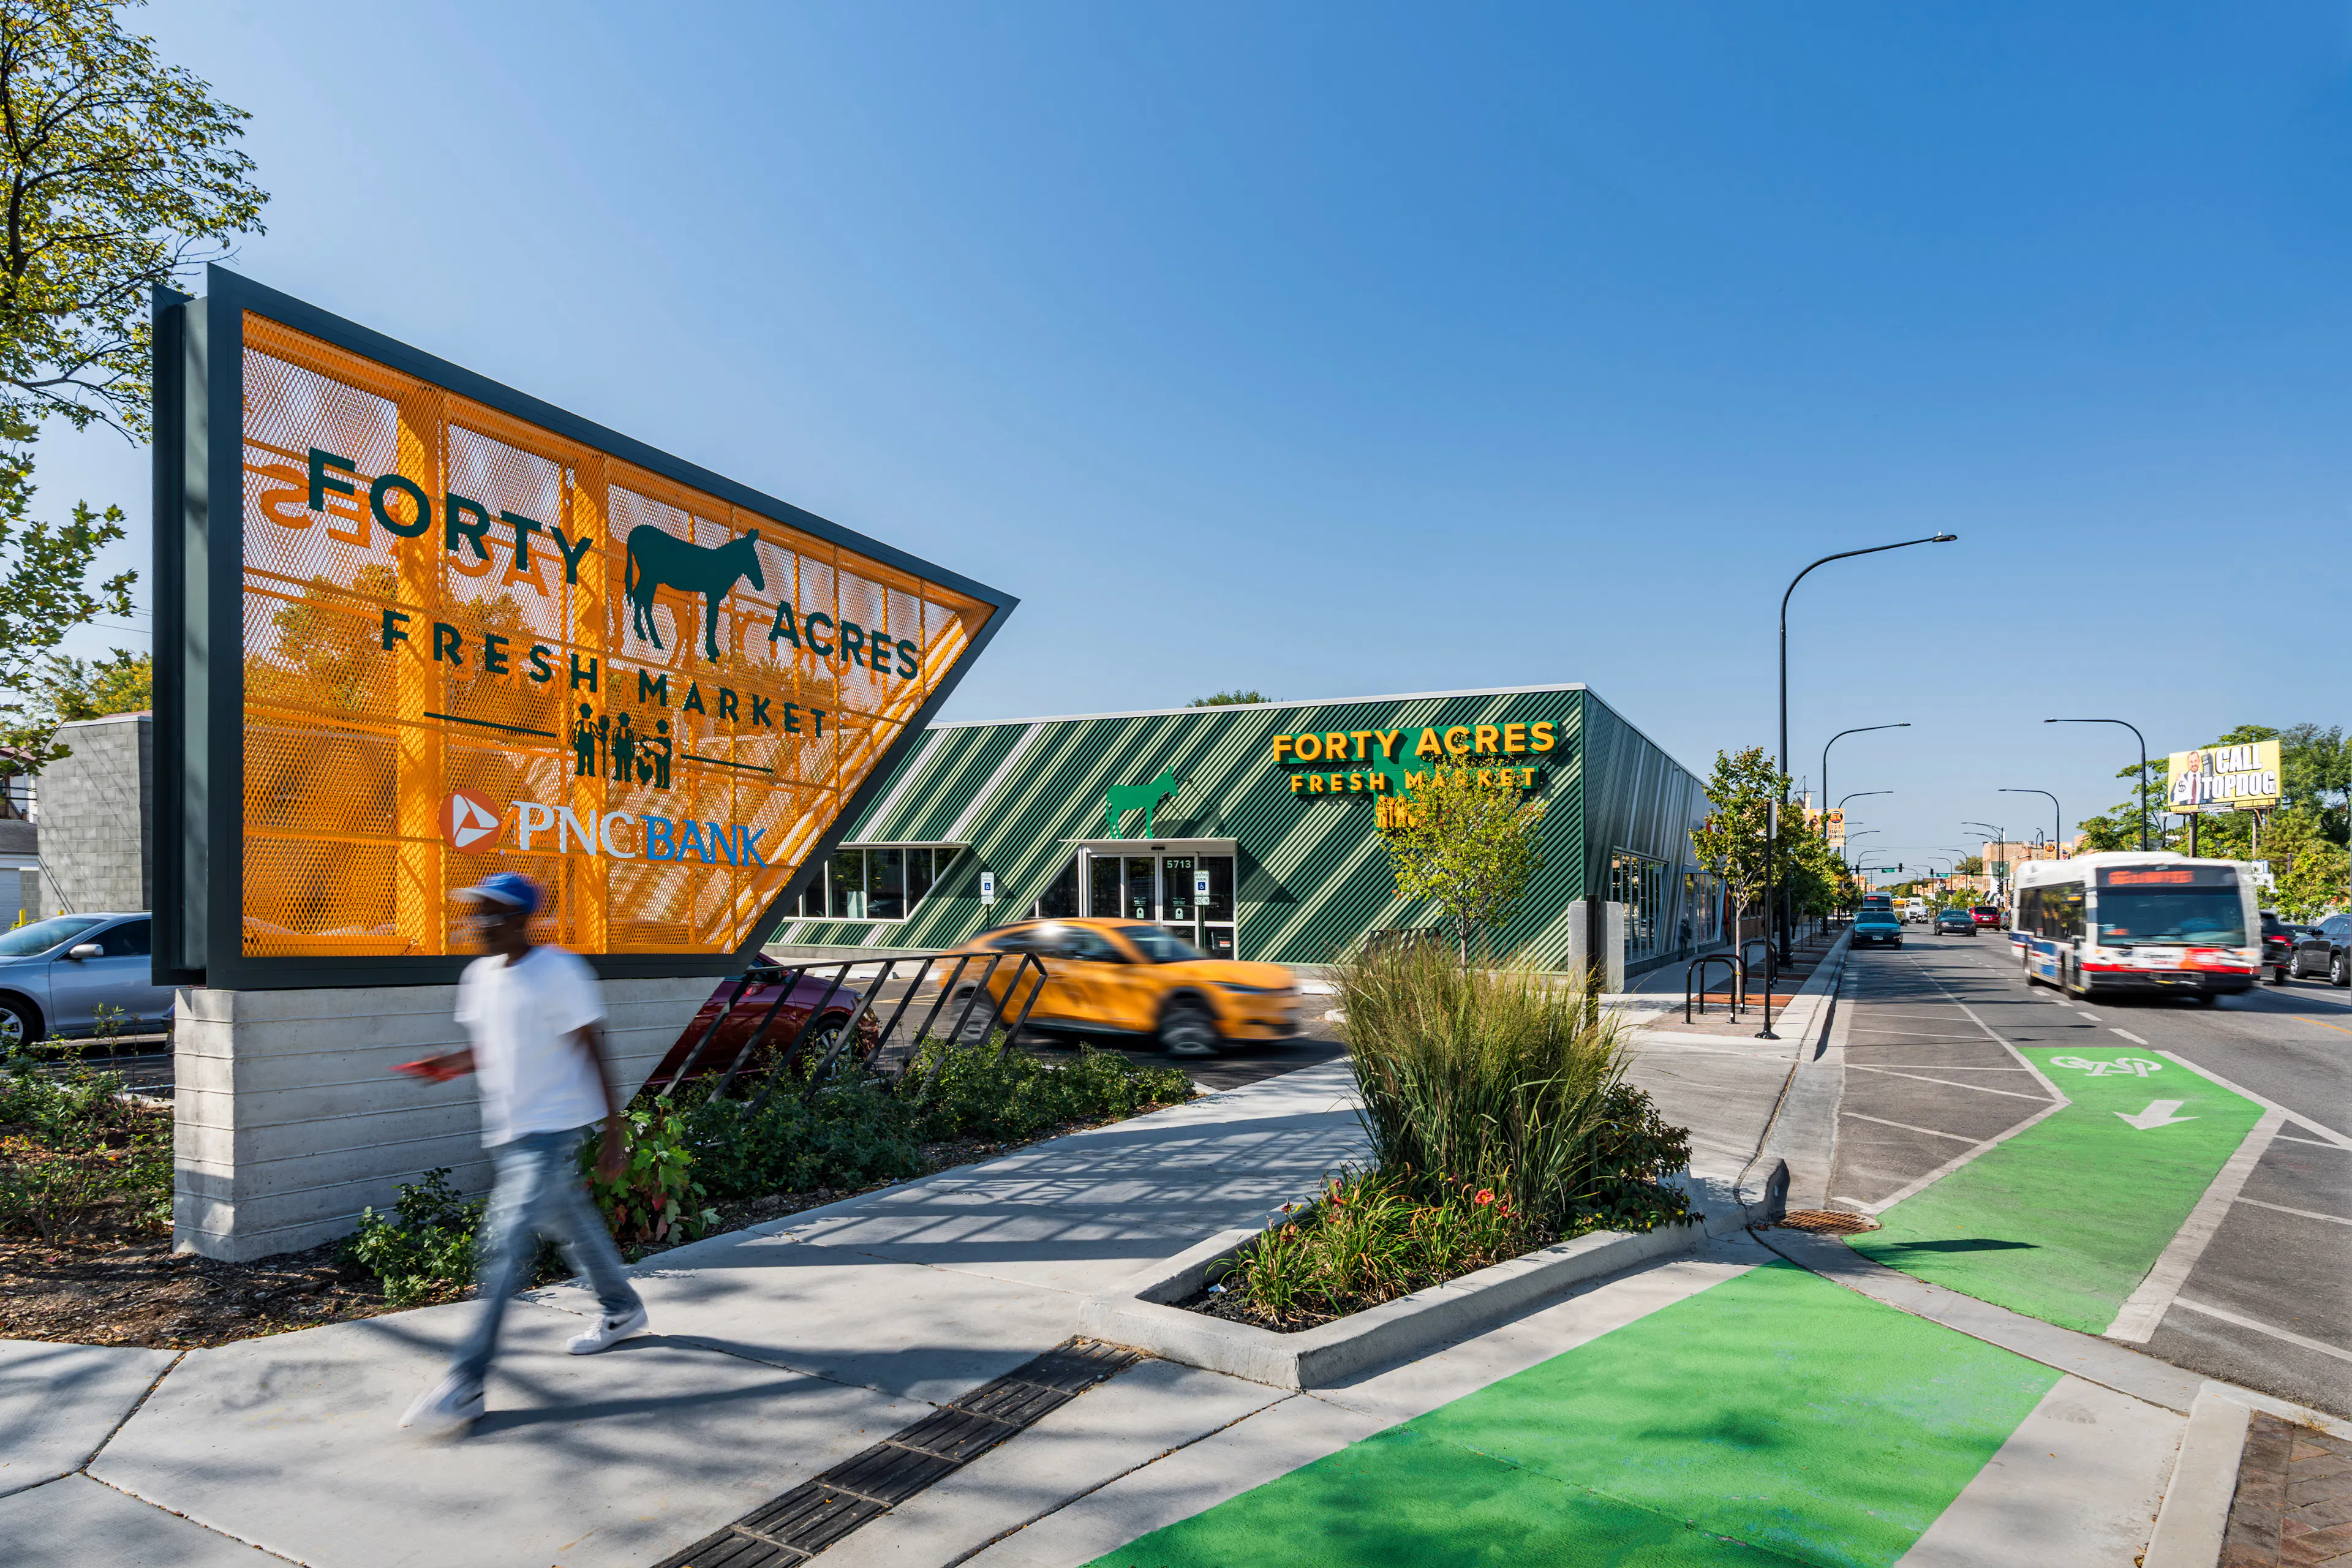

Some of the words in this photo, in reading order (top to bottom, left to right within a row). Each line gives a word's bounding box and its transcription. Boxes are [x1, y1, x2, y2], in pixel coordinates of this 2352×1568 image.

[309, 447, 594, 585] FORTY
[767, 601, 919, 680] ACRES
[382, 609, 598, 693] FRESH
[638, 669, 826, 739] MARKET
[1273, 729, 1400, 762] FORTY
[1414, 721, 1555, 756] ACRES
[2215, 744, 2263, 774] CALL
[1291, 772, 1385, 793] FRESH
[2201, 770, 2276, 799] TOPDOG
[511, 800, 636, 859] PNC
[640, 814, 768, 869] BANK
[1167, 860, 1191, 869] 5713
